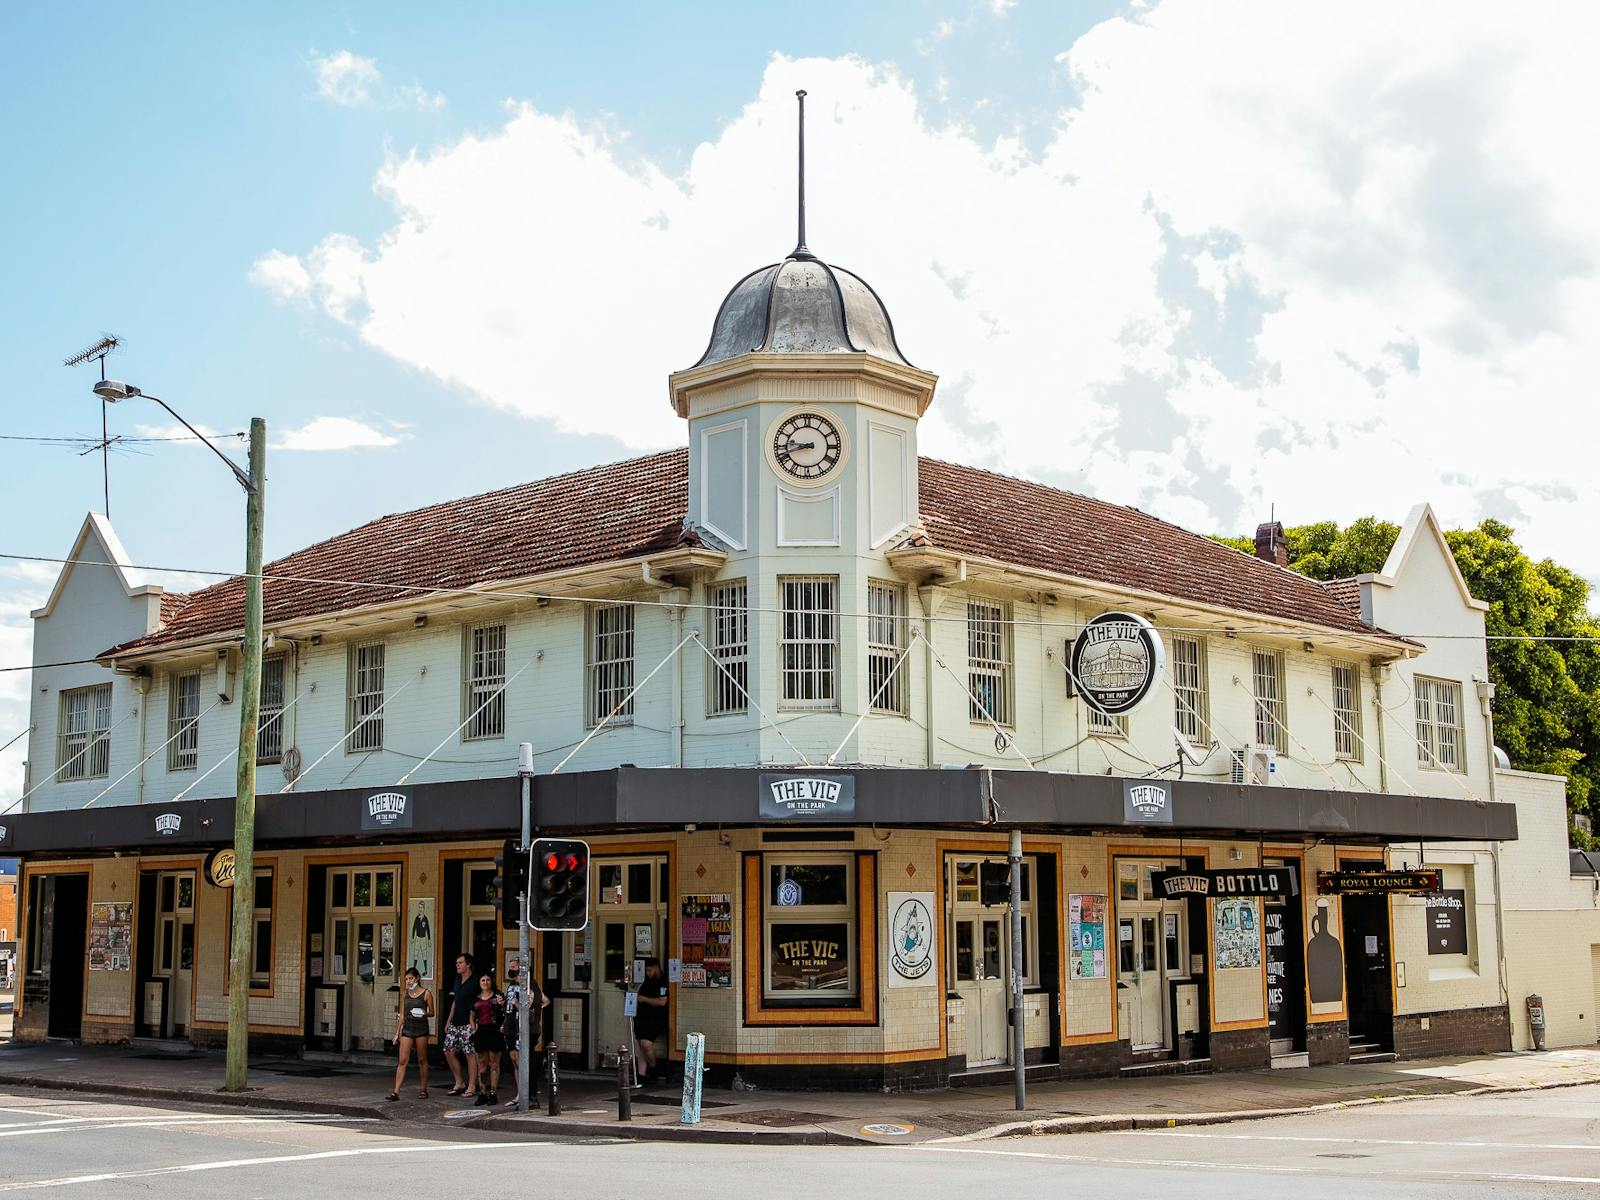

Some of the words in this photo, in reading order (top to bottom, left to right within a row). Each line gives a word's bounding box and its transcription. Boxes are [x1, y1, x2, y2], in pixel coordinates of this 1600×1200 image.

[1089, 624, 1112, 642] THE
[1115, 622, 1137, 640] VIC
[773, 781, 805, 801] THE
[808, 781, 837, 801] VIC
[1132, 787, 1148, 804] THE
[1149, 787, 1164, 805] VIC
[370, 796, 387, 813] THE
[388, 794, 404, 812] VIC
[156, 815, 168, 830] THE
[168, 815, 180, 829] VIC
[1165, 877, 1186, 892] THE
[1187, 877, 1206, 892] VIC
[1216, 874, 1279, 893] BOTTLO
[1340, 879, 1370, 887] ROYAL
[1373, 878, 1413, 887] LOUNGE
[1431, 896, 1447, 907] Bottle
[780, 941, 809, 959] THE
[811, 940, 838, 959] VIC
[895, 958, 908, 975] THE
[910, 960, 929, 976] JETS
